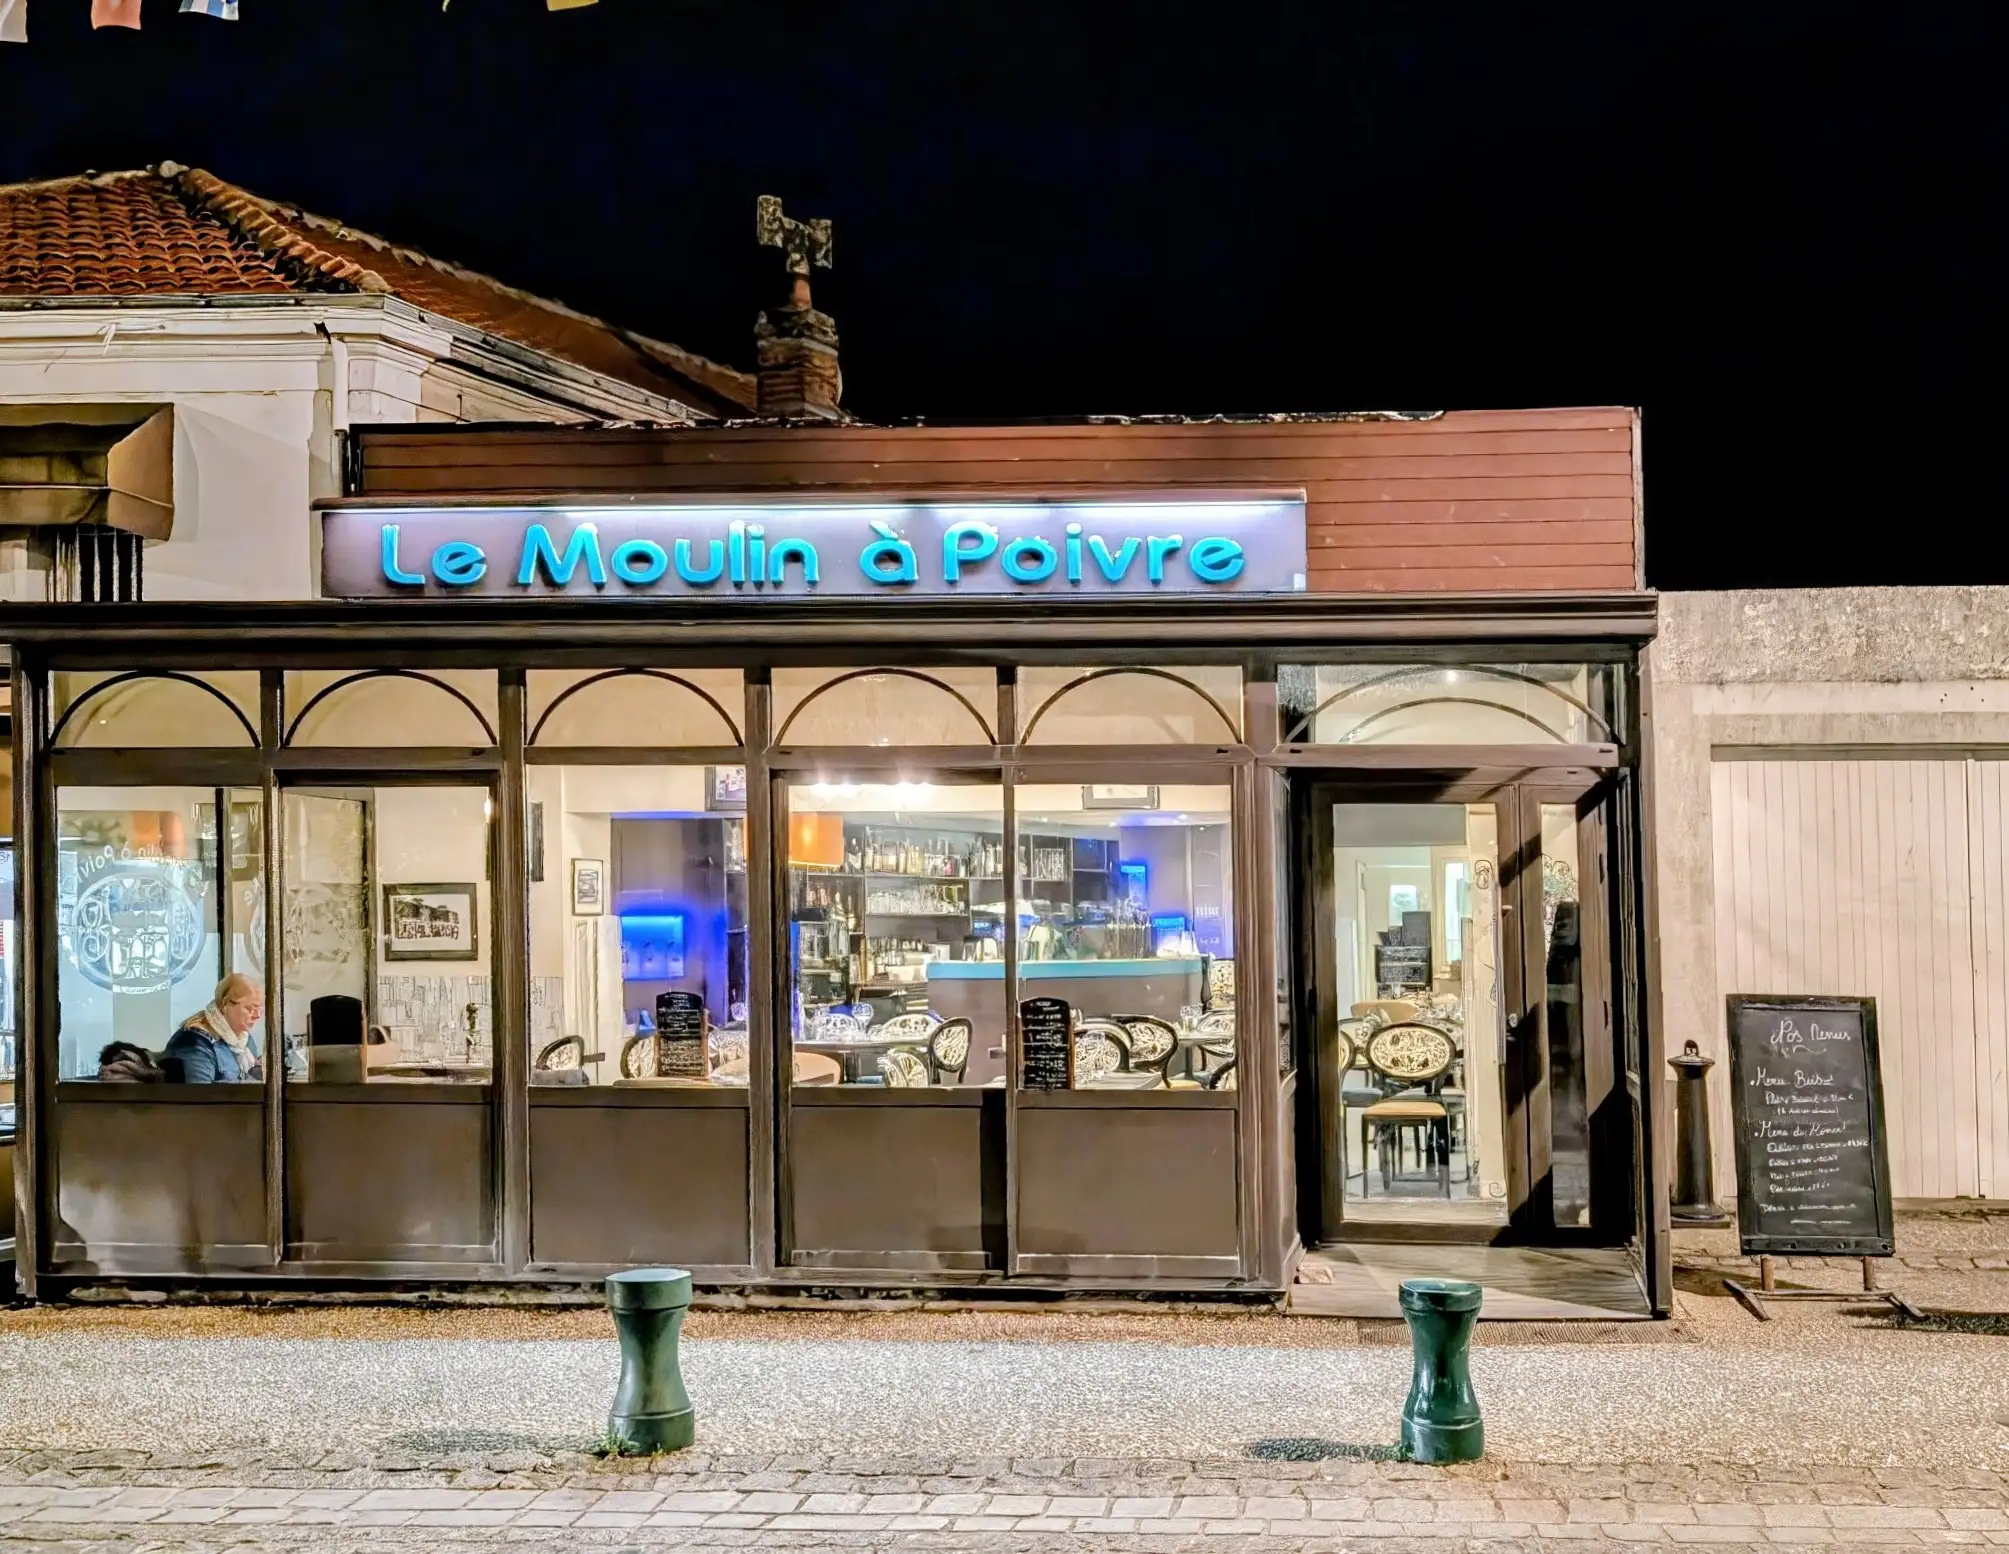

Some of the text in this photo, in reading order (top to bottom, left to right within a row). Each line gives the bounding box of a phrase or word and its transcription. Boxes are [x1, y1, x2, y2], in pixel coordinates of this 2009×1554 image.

[380, 519, 1246, 587] Le Moulin à Poivre
